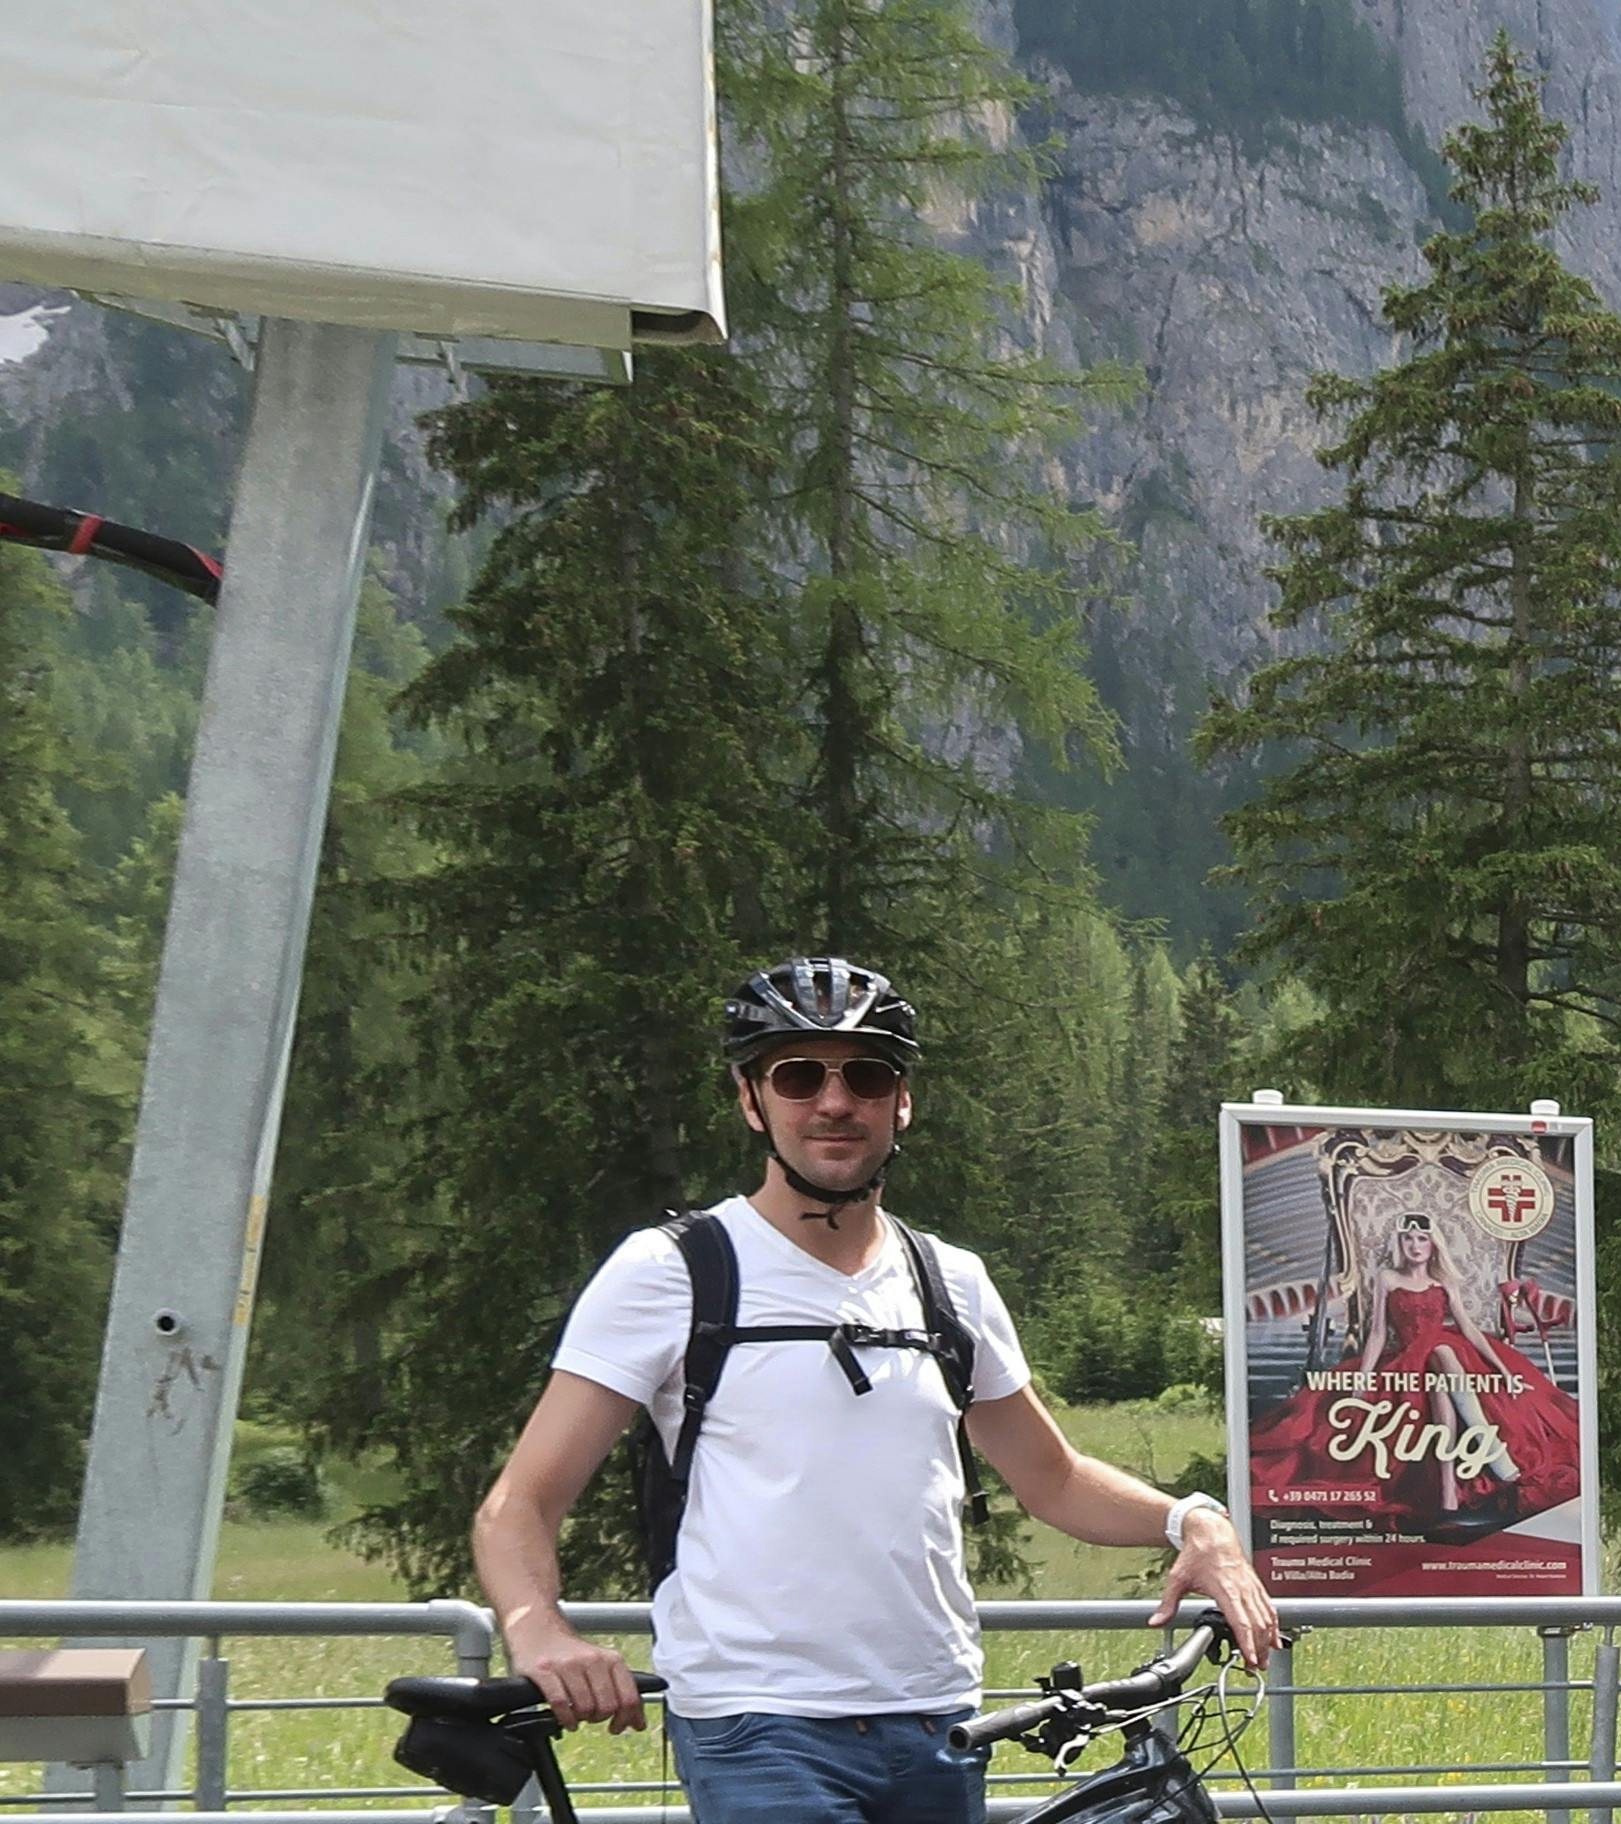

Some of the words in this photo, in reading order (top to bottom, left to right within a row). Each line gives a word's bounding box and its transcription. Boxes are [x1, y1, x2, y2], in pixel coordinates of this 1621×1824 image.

[1307, 1371, 1377, 1391] WHERE
[1382, 1372, 1420, 1392] THE
[1425, 1373, 1503, 1394] PATIENT
[1506, 1374, 1524, 1394] IS
[1328, 1397, 1508, 1480] King
[1319, 1520, 1363, 1529] treatment
[1279, 1534, 1318, 1545] required
[1319, 1535, 1353, 1545] surgery
[1355, 1534, 1383, 1543] within
[1385, 1533, 1397, 1543] 24
[1270, 1557, 1306, 1567] Trauma
[1307, 1557, 1343, 1566] Medical
[1345, 1556, 1372, 1566] Clinic
[1421, 1560, 1567, 1570] www.traumamedicalclinic.com
[1271, 1571, 1283, 1580] La
[1329, 1570, 1355, 1580] Badia
